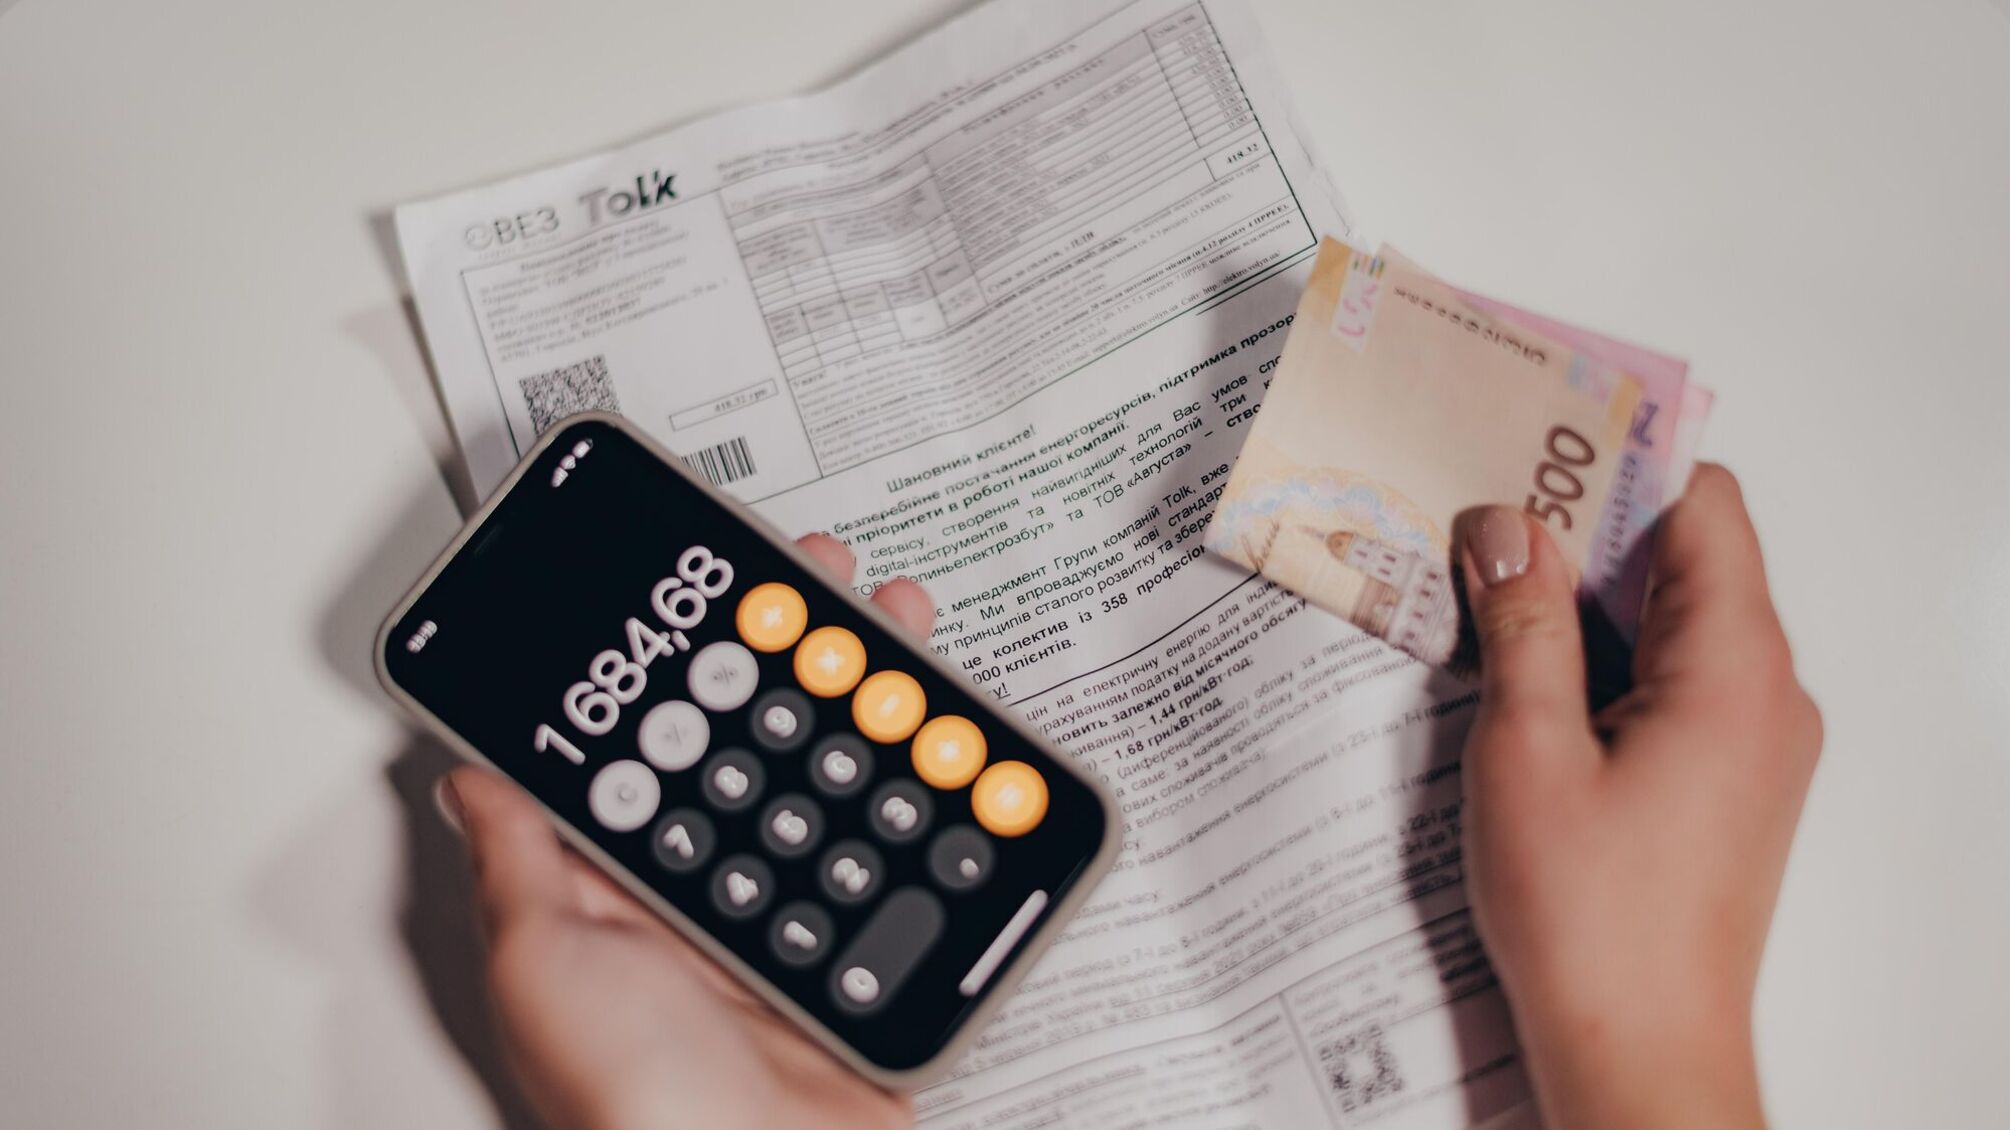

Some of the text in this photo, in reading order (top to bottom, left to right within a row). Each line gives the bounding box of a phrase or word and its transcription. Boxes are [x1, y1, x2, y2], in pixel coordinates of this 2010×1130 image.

[578, 170, 678, 230] Tolk
[833, 311, 1297, 534] безперебійне постачання енергоресурсів, підтримка прозор
[886, 424, 1035, 493] Шановний клієнте!
[941, 497, 1020, 536] створення
[1030, 446, 1127, 498] найвигідніших
[1137, 422, 1162, 446] для
[1172, 400, 1201, 422] Вас
[1210, 374, 1248, 403] умов
[1523, 424, 1596, 532] 500
[855, 419, 1129, 543] пріоритети в роботі нашої компанії.
[865, 393, 1247, 577] digital-інструментів та новітніх технологій три
[951, 565, 1046, 612] менеджмент
[1052, 544, 1098, 570] Групи
[1102, 504, 1160, 548] компаній
[1161, 485, 1196, 508] Tolk,
[1200, 462, 1229, 485] вже
[1065, 508, 1084, 521] та
[1092, 483, 1124, 508] ТОВ
[1126, 442, 1191, 488] «Августа»
[930, 619, 968, 638] инку.
[979, 603, 1005, 620] Ми
[1016, 551, 1124, 605] впроваджуємо
[1132, 527, 1160, 551] нові
[953, 611, 1031, 649] принципів
[1034, 585, 1094, 615] сталого
[1096, 550, 1155, 593] розвитку
[1156, 539, 1174, 554] та
[1174, 509, 1215, 544] збере
[961, 655, 982, 670] це
[992, 620, 1068, 659] колектив
[1077, 610, 1093, 623] із
[1100, 591, 1128, 613] 358
[1004, 638, 1076, 673] клієнтів.
[1025, 705, 1048, 721] цін
[1055, 693, 1074, 708] на
[1082, 655, 1158, 697] електричну
[1165, 623, 1210, 658] енергію
[1217, 603, 1240, 626] для
[1111, 688, 1170, 723] залежно
[1172, 673, 1195, 692] від
[1194, 631, 1258, 677] місячного
[1260, 596, 1309, 633] обсягу
[1130, 662, 1180, 696] податку
[1180, 652, 1196, 667] на
[1197, 624, 1241, 658] додану
[1114, 739, 1144, 759] 1,68
[1116, 697, 1248, 779] (диференційованого)
[1254, 670, 1293, 698] обліку
[1300, 655, 1316, 669] за
[1149, 704, 1176, 725] 1,44
[1174, 757, 1189, 771] за
[1191, 718, 1249, 759] наявності
[1253, 691, 1292, 719] обліку
[663, 703, 798, 860] 7 8 9
[725, 749, 858, 907] 4 5 6
[782, 795, 918, 950] 1 2 3
[840, 965, 880, 1002] 0
